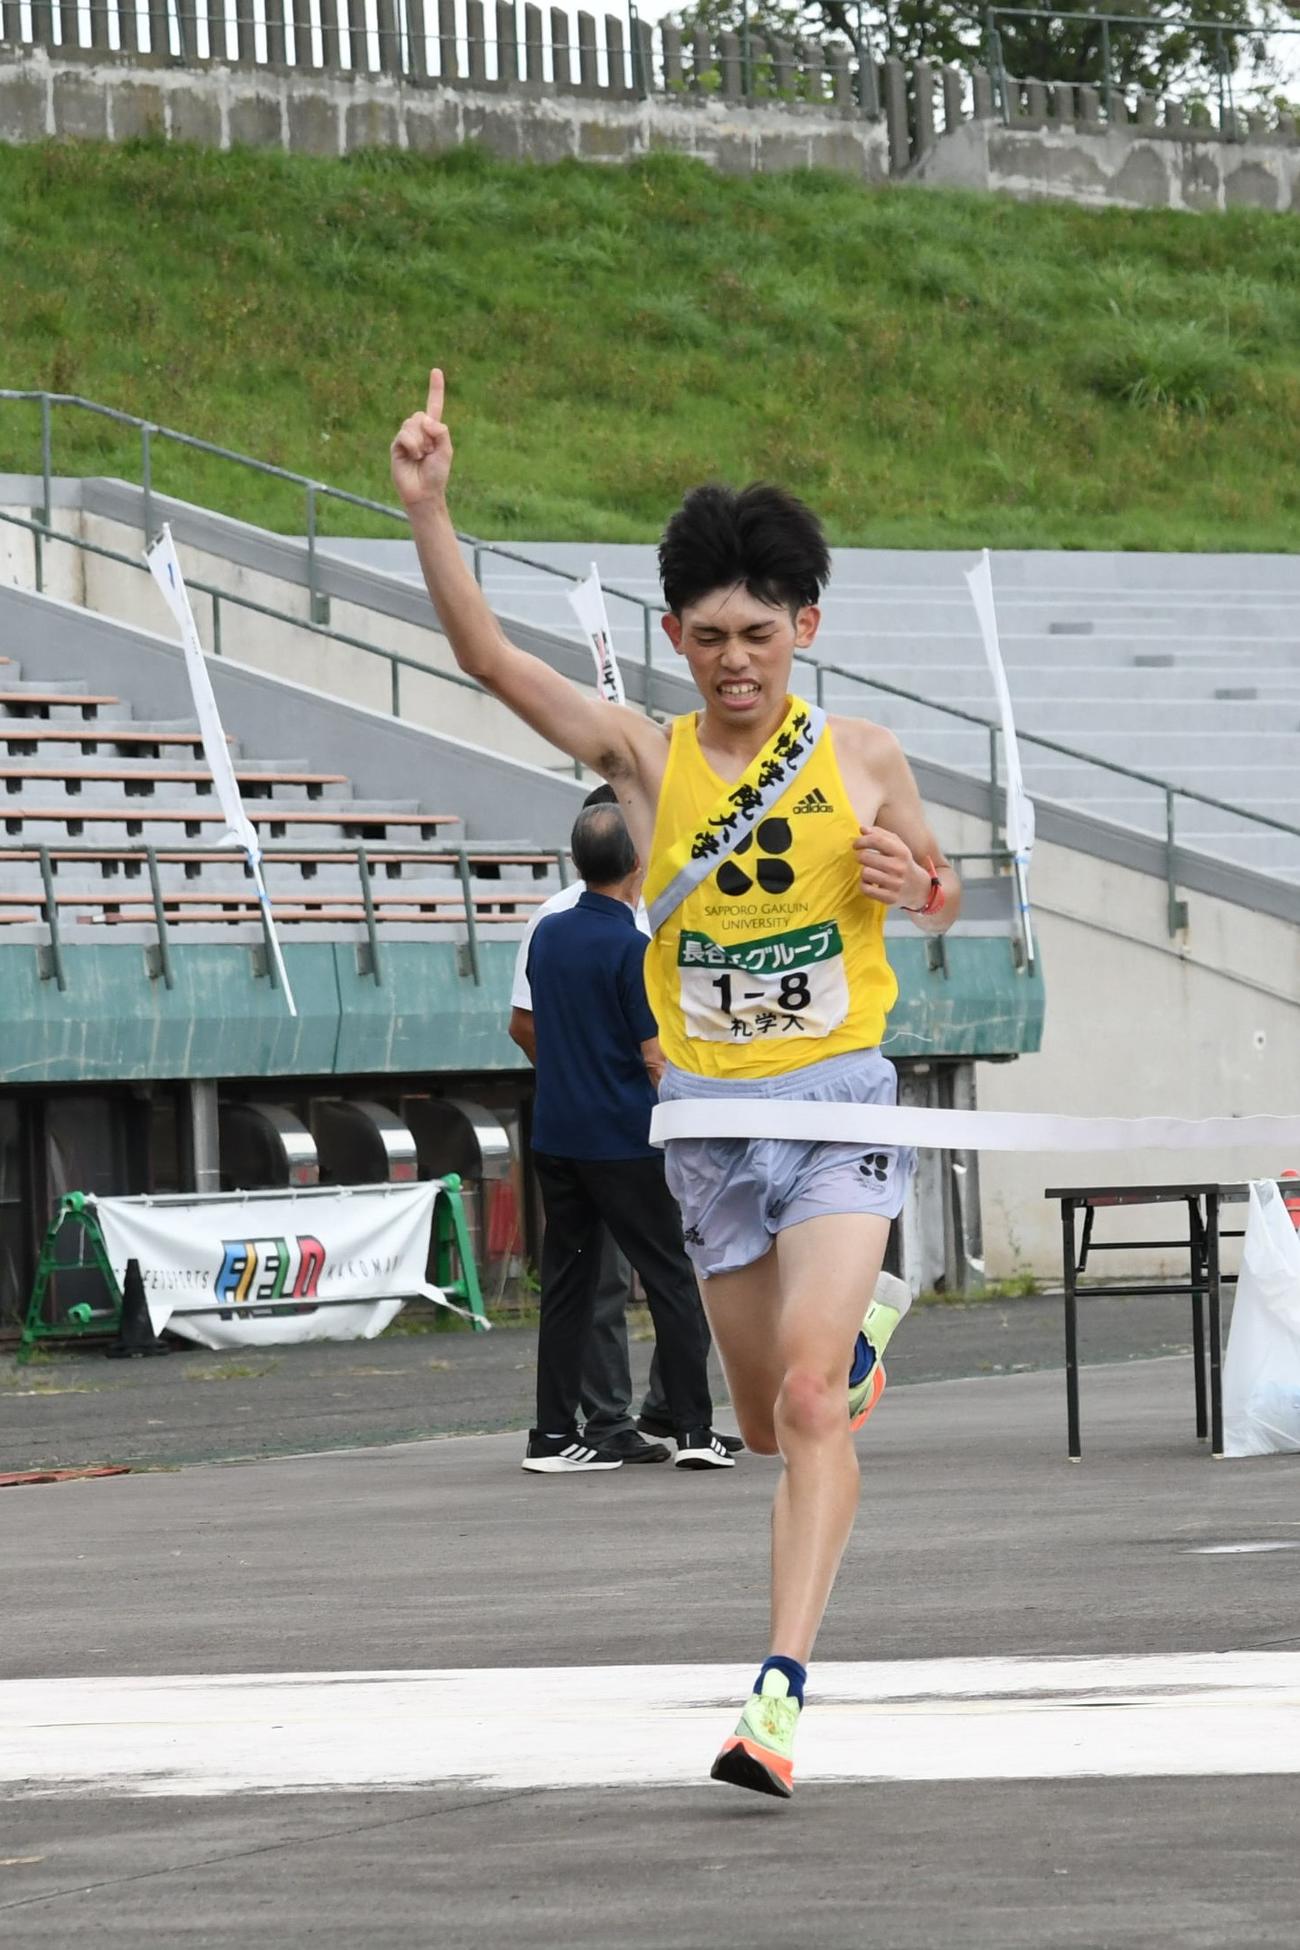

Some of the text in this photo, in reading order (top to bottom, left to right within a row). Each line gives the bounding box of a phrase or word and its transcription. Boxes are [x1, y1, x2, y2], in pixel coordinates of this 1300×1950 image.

[792, 803, 834, 815] adidas
[704, 902, 809, 917] SAPPORO GAKUIN
[721, 917, 791, 931] UNIVERSITY
[730, 1012, 805, 1037] 札学大
[214, 1235, 326, 1321] FIELD
